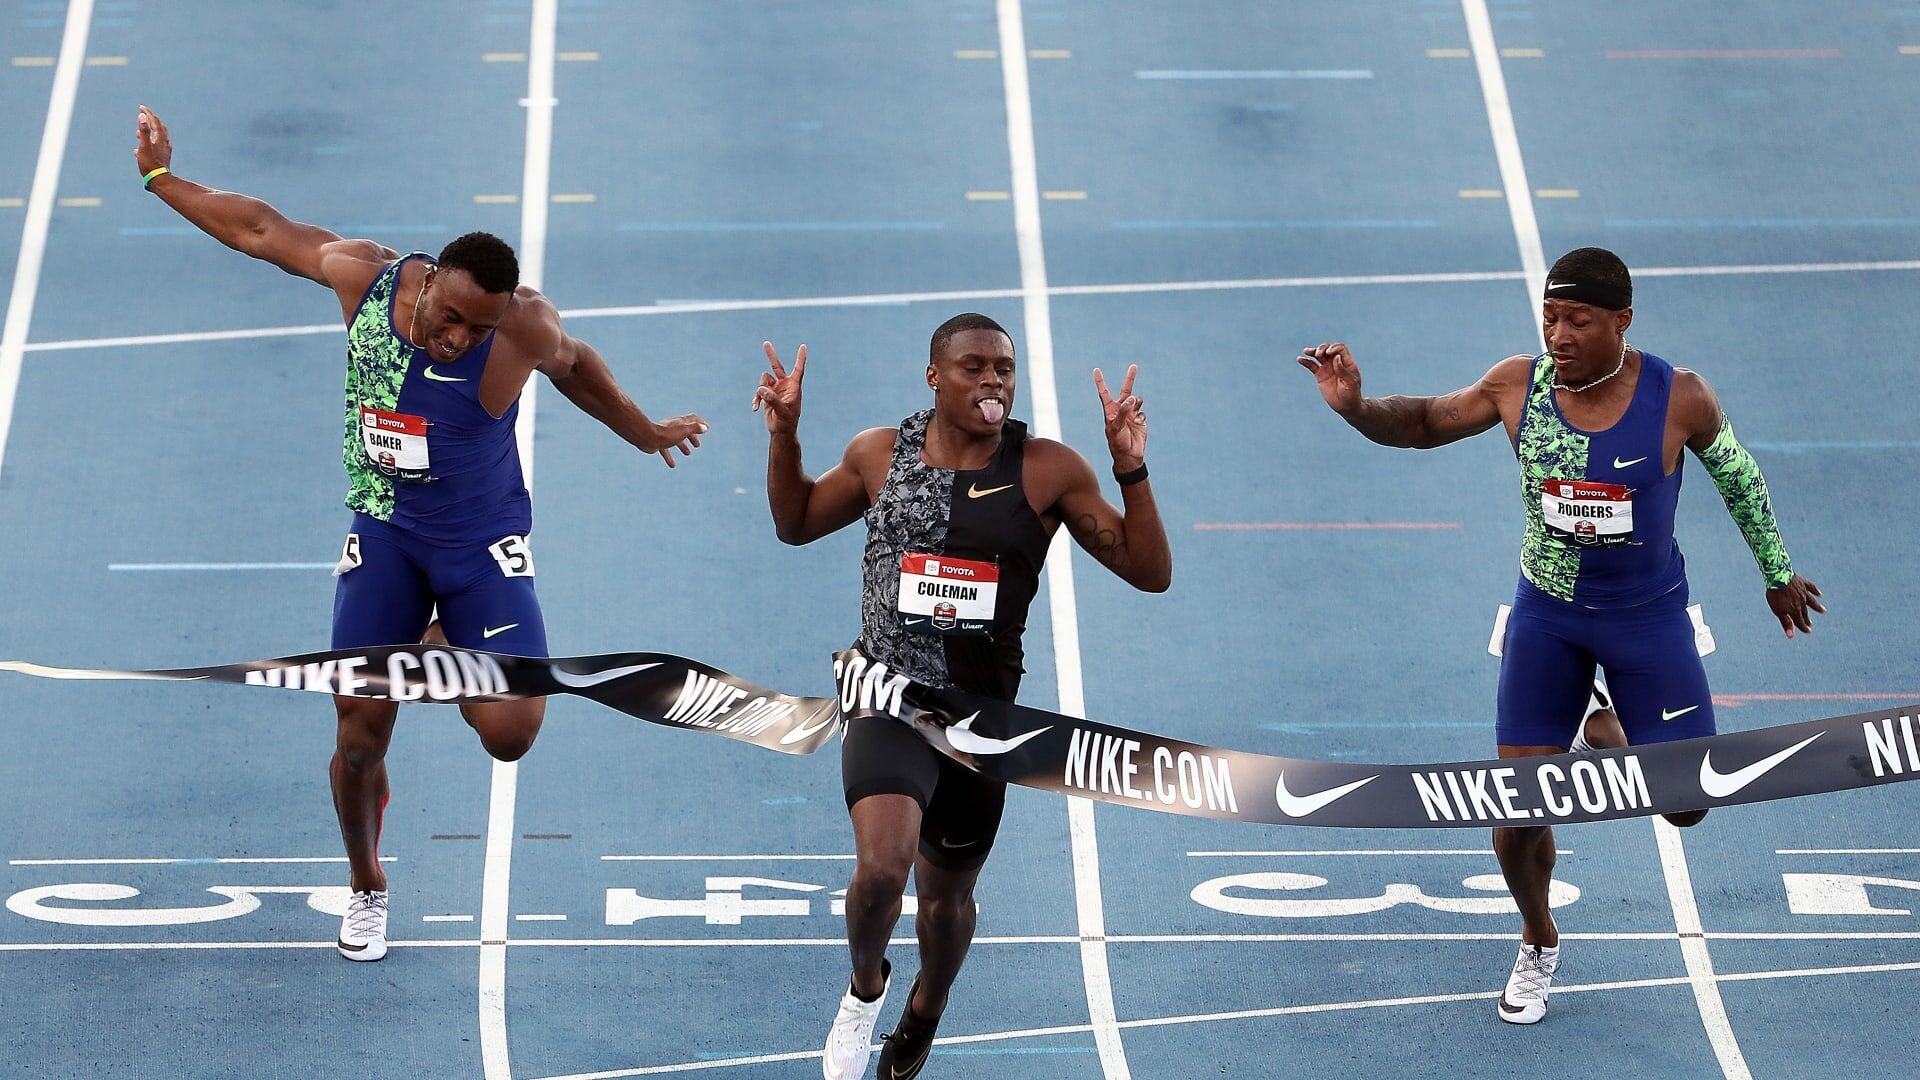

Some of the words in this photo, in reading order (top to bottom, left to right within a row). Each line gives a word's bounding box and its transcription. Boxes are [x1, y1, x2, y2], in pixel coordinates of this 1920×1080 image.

[379, 418, 406, 429] TOYOTA
[369, 432, 402, 450] BAKER
[1575, 489, 1608, 498] TOYOTA
[1557, 502, 1614, 519] RODGERS
[499, 538, 528, 573] 5
[941, 565, 975, 577] TOYOTA
[917, 581, 978, 601] COLEMAN
[663, 669, 799, 737] NIKE.COM
[1862, 713, 1920, 777] NI
[1064, 728, 1240, 814] NIKE.COM
[1412, 755, 1653, 822] NIKE.COM
[1190, 872, 1581, 917] 3
